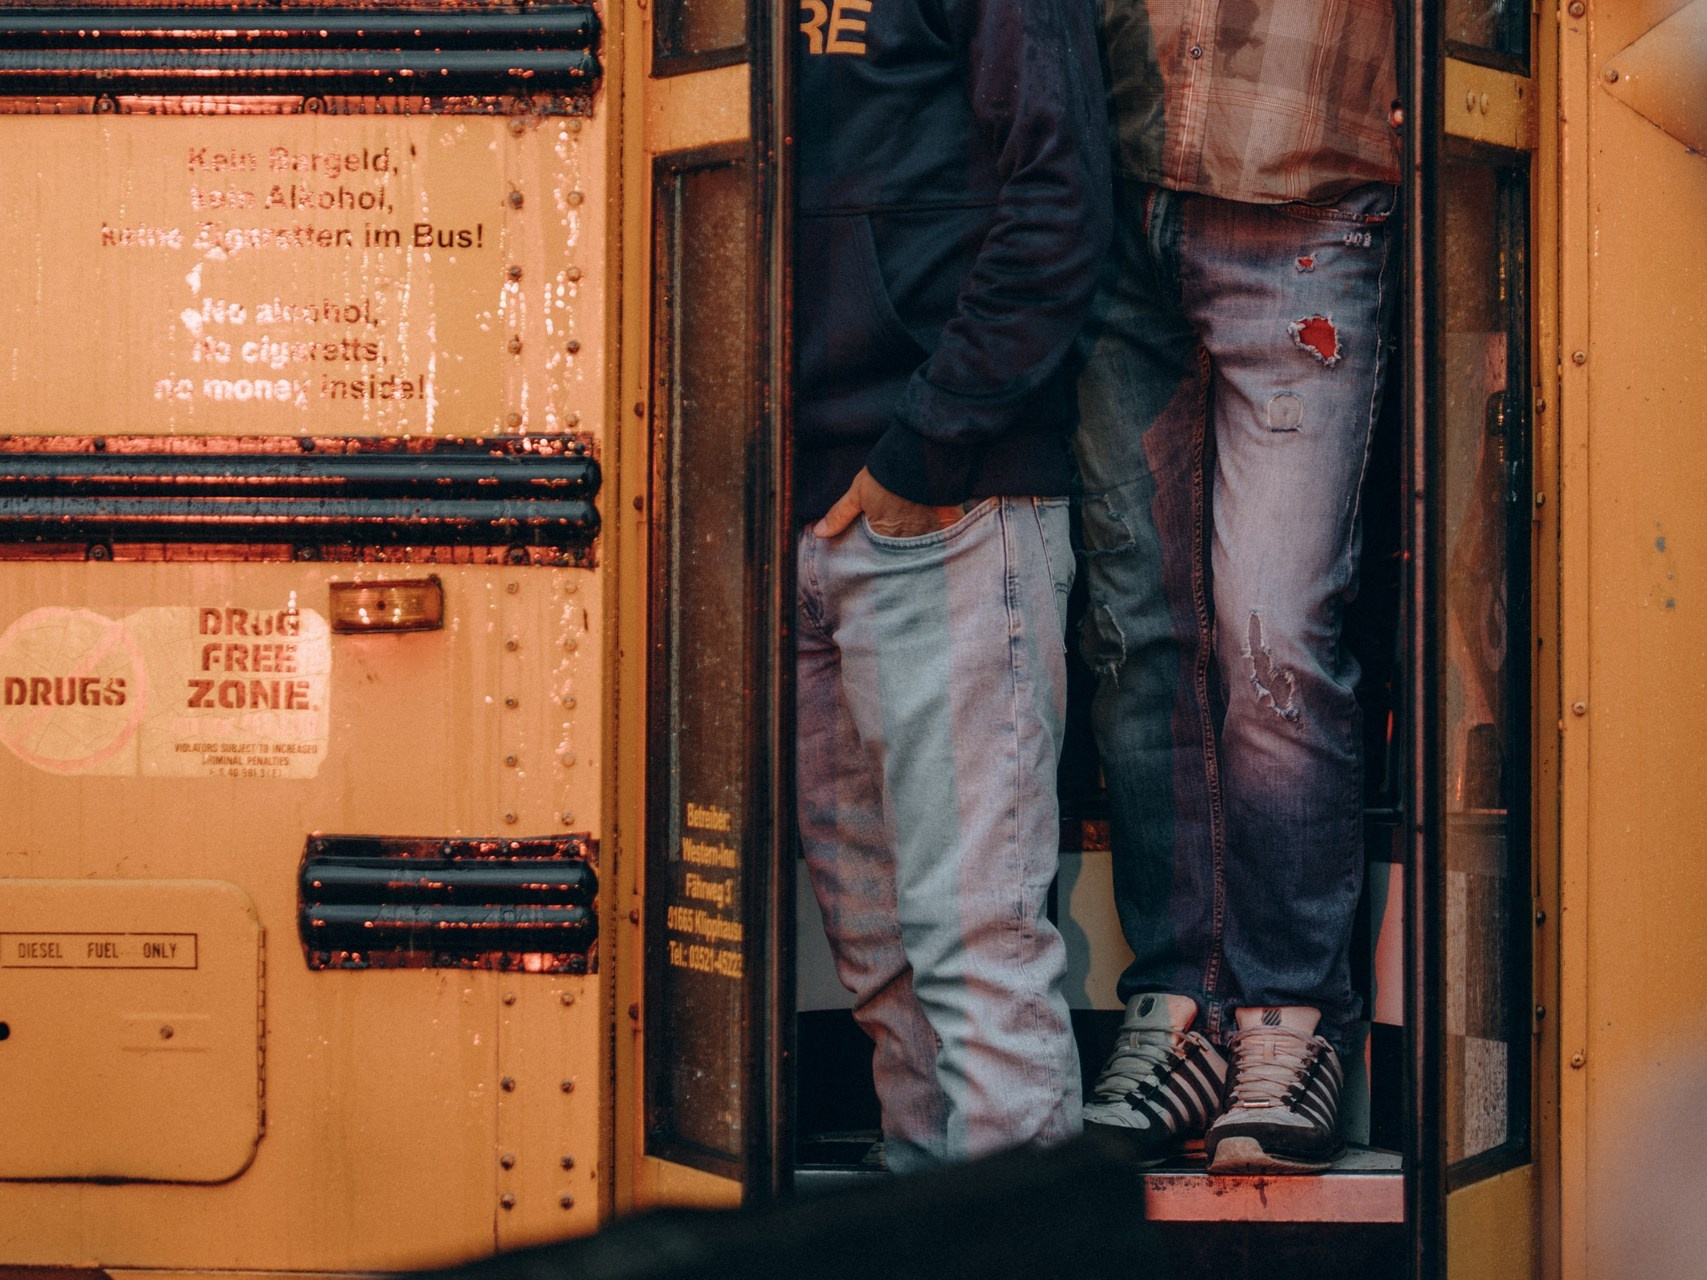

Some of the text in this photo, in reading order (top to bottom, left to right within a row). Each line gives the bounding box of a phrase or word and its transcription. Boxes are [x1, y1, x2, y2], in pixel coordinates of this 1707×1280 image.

[188, 145, 398, 179] Kein Bargeld,
[264, 184, 393, 214] Alkohol,
[365, 223, 400, 248] im
[413, 223, 483, 248] Bus!
[256, 297, 378, 327] alcohol,
[154, 374, 425, 408] no money inside!
[199, 607, 300, 637] DRUG
[202, 642, 298, 673] FREE
[4, 677, 127, 706] DRUGS
[174, 743, 318, 754] VIOLATORS SUBJECT TO INCREASED
[246, 755, 290, 766] PENALTIES
[18, 942, 178, 959] DIESEL FUEL ONLY
